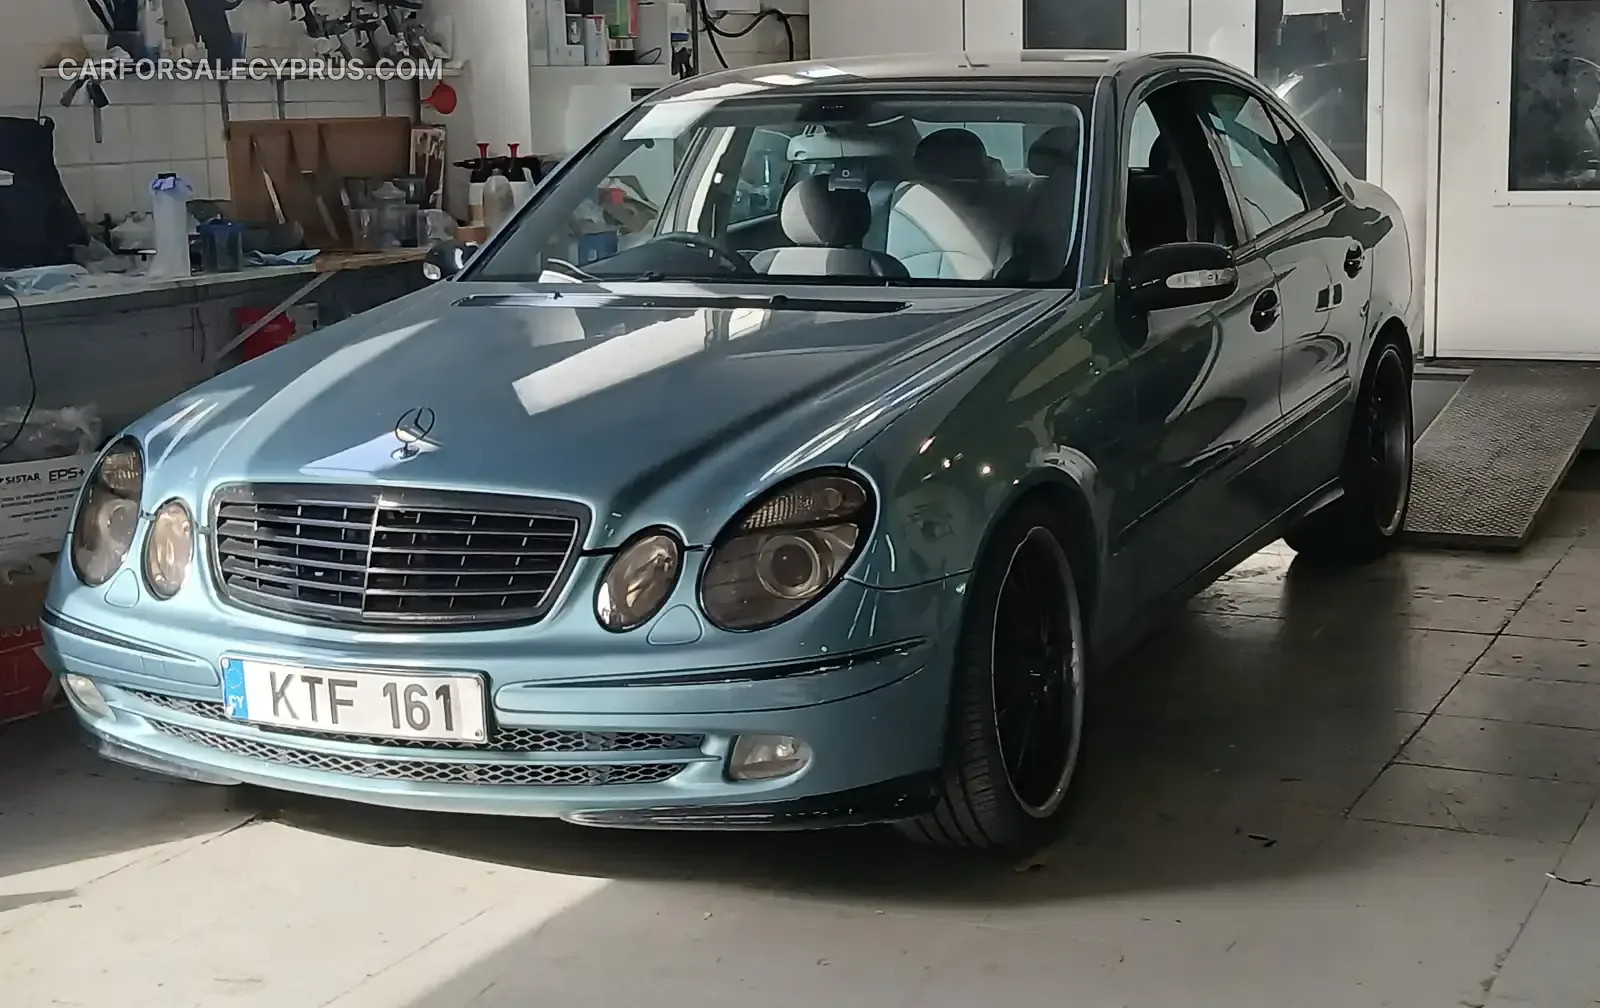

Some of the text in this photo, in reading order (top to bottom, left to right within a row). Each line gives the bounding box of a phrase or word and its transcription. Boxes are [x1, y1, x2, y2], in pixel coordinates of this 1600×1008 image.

[49, 467, 85, 482] EPS+
[269, 671, 454, 731] KTF 161
